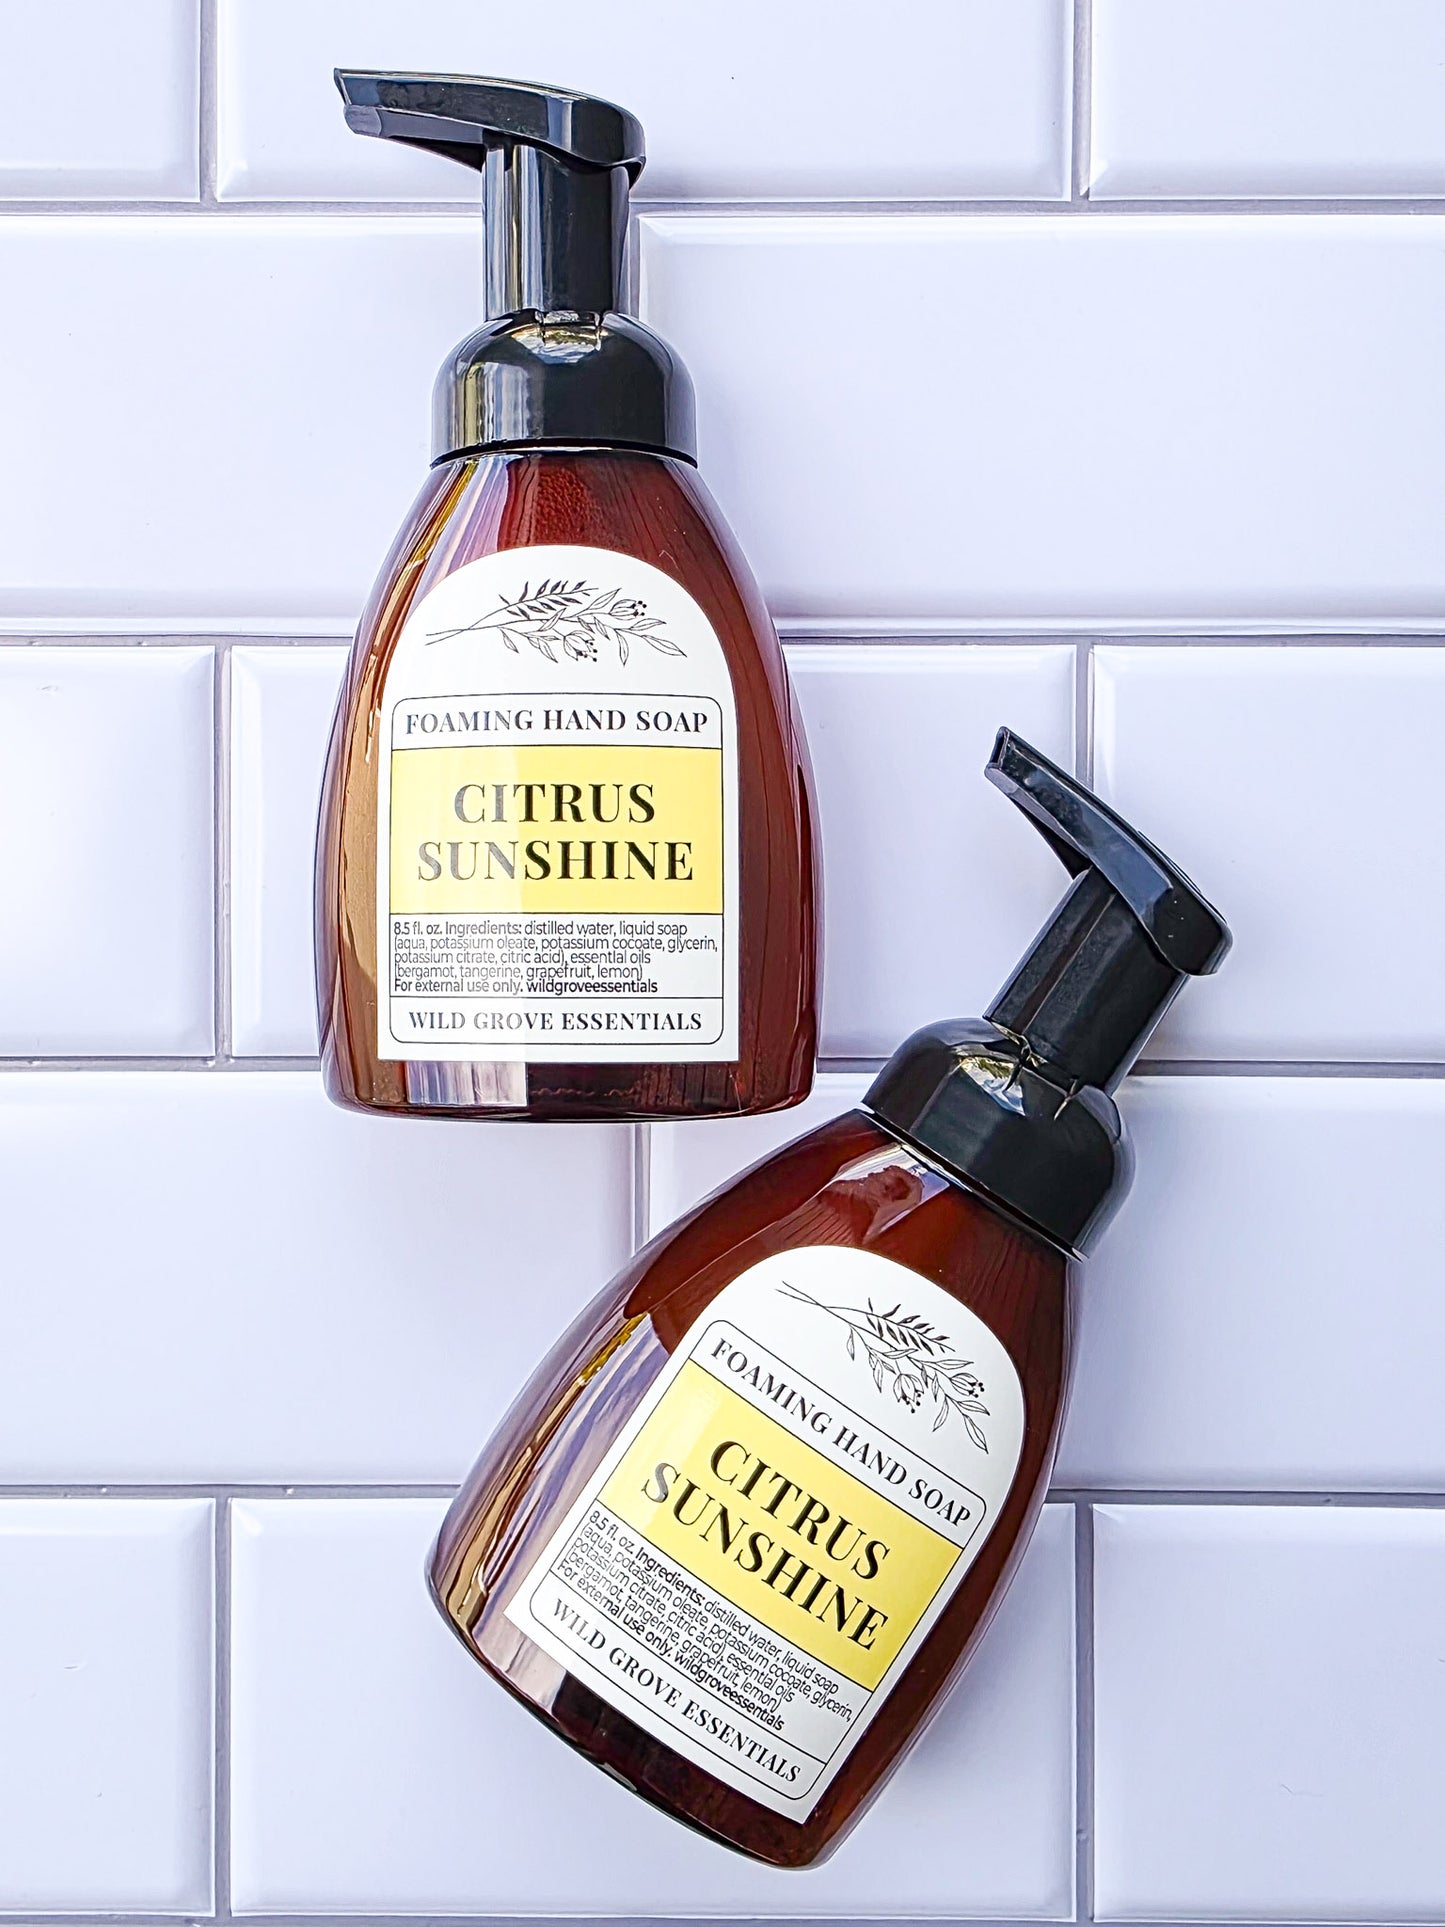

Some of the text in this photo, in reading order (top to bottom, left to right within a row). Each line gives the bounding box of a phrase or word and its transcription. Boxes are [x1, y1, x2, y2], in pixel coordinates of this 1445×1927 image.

[405, 709, 708, 735] FOAMING HAND SOAP
[454, 783, 656, 824] CITRUS
[418, 840, 694, 882] SUNSHINE
[394, 950, 453, 966] potassium
[456, 950, 498, 965] citrate,
[500, 950, 531, 964] citric
[630, 950, 651, 964] oils
[412, 921, 423, 935] fl.
[426, 923, 442, 935] oz.
[445, 920, 522, 938] Ingredients:
[524, 920, 574, 935] distilled
[576, 922, 616, 937] water,
[619, 920, 655, 938] liquid
[657, 923, 688, 939] soap
[430, 935, 494, 952] potassium
[497, 936, 538, 951] oleate,
[541, 935, 609, 951] potassium
[612, 937, 665, 951] cocoate,
[667, 935, 718, 953] glycerin,
[394, 978, 658, 996] For external use only. wildgroveessentials
[459, 964, 524, 980] tangerine,
[526, 964, 595, 981] grapefruit,
[597, 964, 643, 981] lemon)
[409, 1011, 702, 1031] WILD GROVE ESSENTIALS
[710, 1337, 972, 1528] FOAMING HAND SOAP
[707, 1438, 891, 1582] CITRUS
[640, 1460, 889, 1652] SUNSHINE
[556, 1559, 786, 1735] For external use only. wildgroveessentials
[571, 1537, 631, 1587] potassium
[628, 1581, 668, 1618] citrate,
[667, 1610, 698, 1637] citric
[774, 1683, 796, 1703] oils
[605, 1523, 620, 1541] fl.
[618, 1536, 636, 1555] oz.
[633, 1546, 707, 1607] Ingredients:
[703, 1599, 751, 1637] distilled
[747, 1630, 783, 1662] water,
[781, 1651, 816, 1681] liquid
[811, 1672, 840, 1697] soap
[612, 1551, 674, 1601] potassium
[671, 1595, 710, 1631] oleate,
[708, 1623, 770, 1669] potassium
[768, 1662, 813, 1699] cocoate,
[809, 1690, 855, 1723] glycerin,
[550, 1598, 801, 1784] WILD GROVE ESSENTIALS
[622, 1595, 682, 1646] tangerine,
[679, 1639, 742, 1688] grapefruit,
[739, 1677, 782, 1714] lemon)
